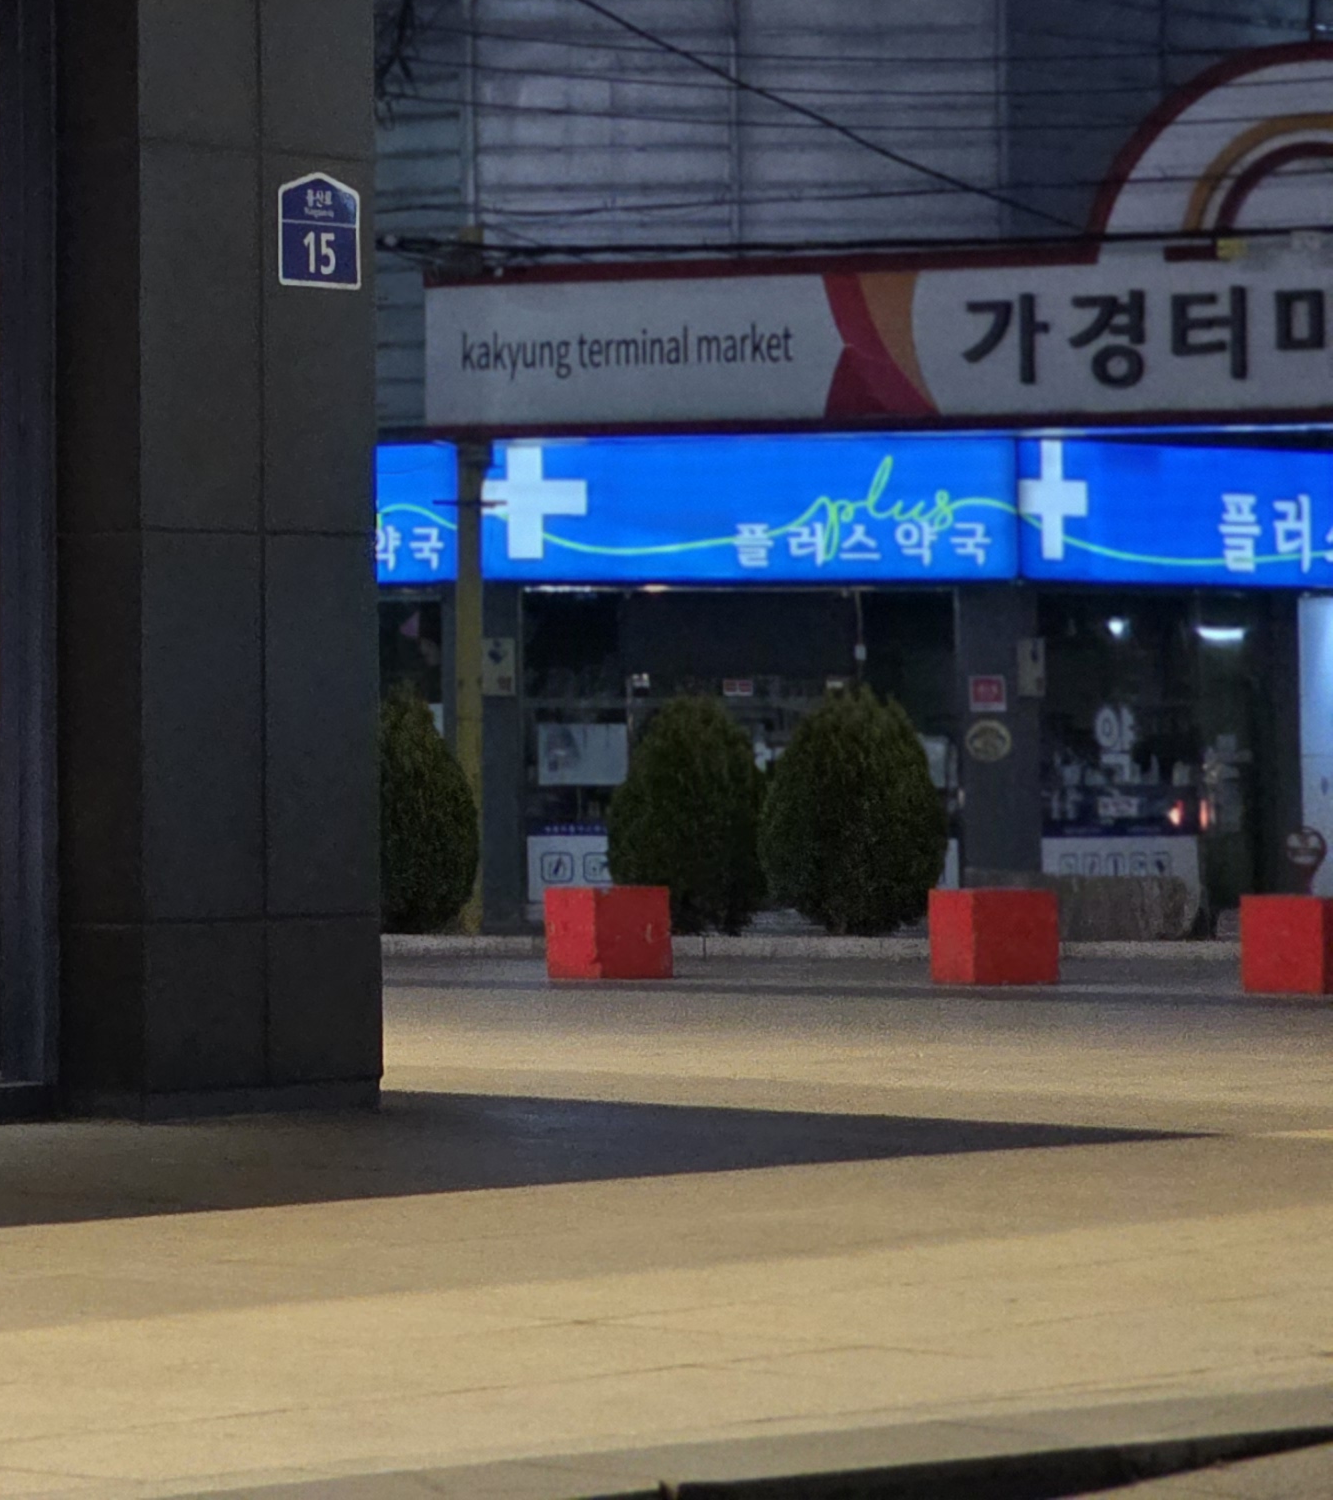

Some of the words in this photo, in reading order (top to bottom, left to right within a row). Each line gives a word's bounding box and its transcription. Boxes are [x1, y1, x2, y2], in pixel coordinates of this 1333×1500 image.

[302, 230, 337, 276] 15
[461, 331, 573, 381] kakyung
[577, 325, 690, 369] terminal
[697, 321, 794, 365] market
[811, 454, 956, 561] plus
